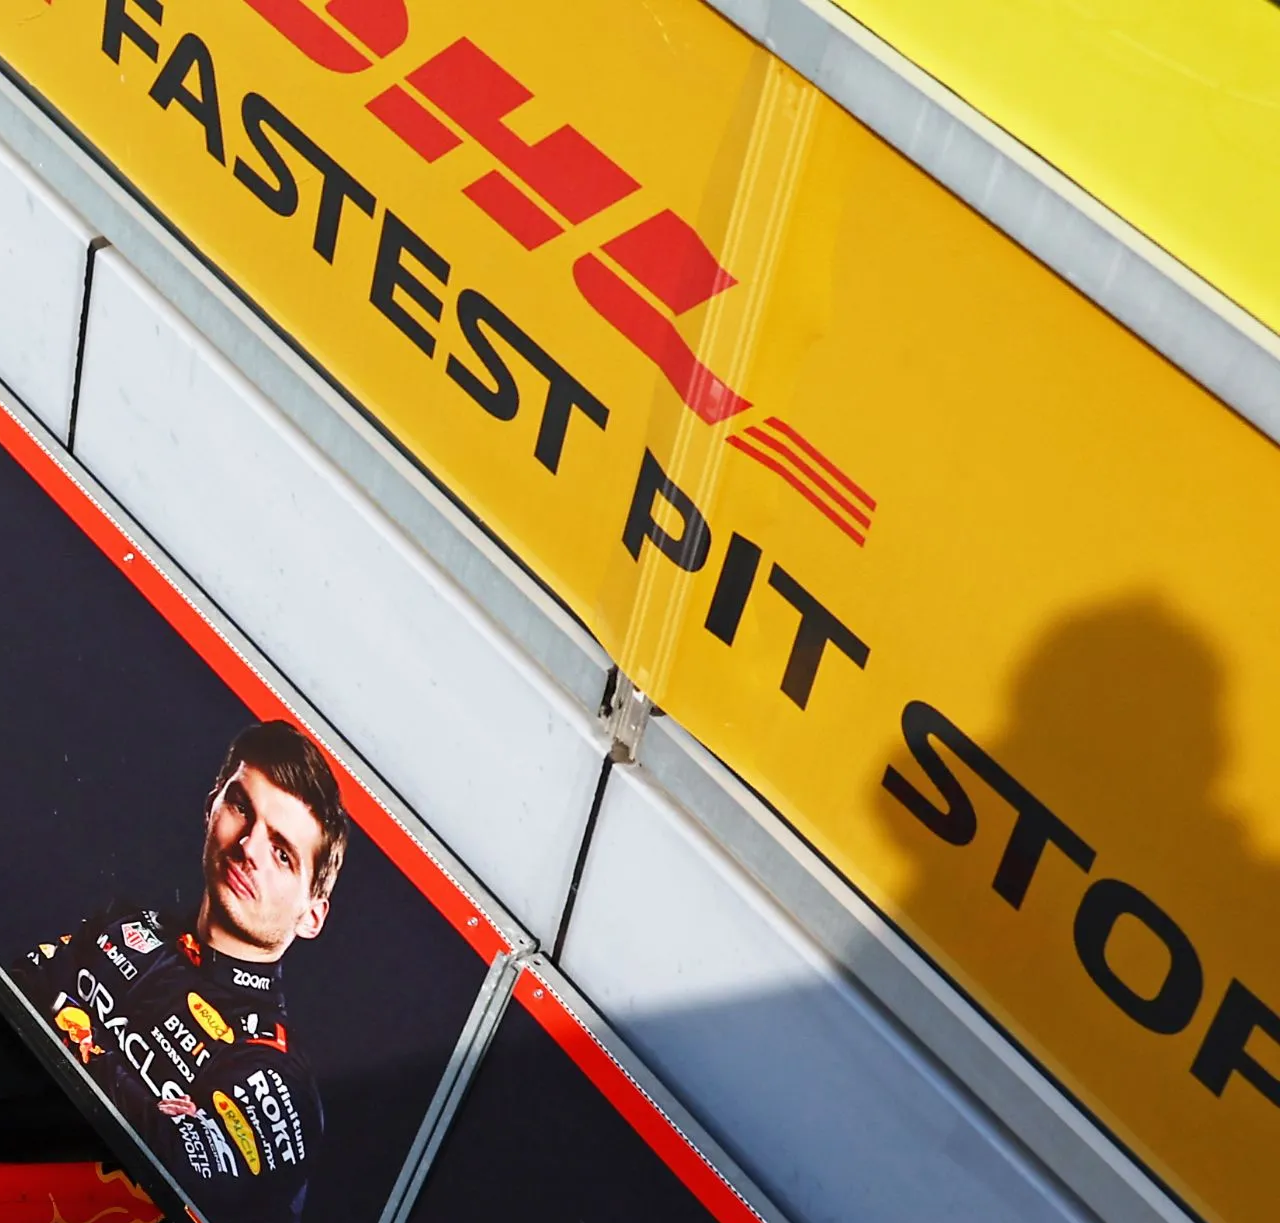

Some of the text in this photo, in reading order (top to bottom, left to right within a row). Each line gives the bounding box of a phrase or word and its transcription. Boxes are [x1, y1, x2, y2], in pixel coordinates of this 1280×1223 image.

[101, 0, 610, 475] FASTEST
[621, 447, 871, 711] PIT
[96, 933, 127, 967] Mobil
[232, 967, 271, 990] zoom
[77, 969, 190, 1100] ORACLE
[225, 1110, 256, 1164] RAUCH
[246, 1070, 297, 1165] ROKT
[178, 1127, 202, 1174] WOLF
[183, 1121, 212, 1180] ARCTIC
